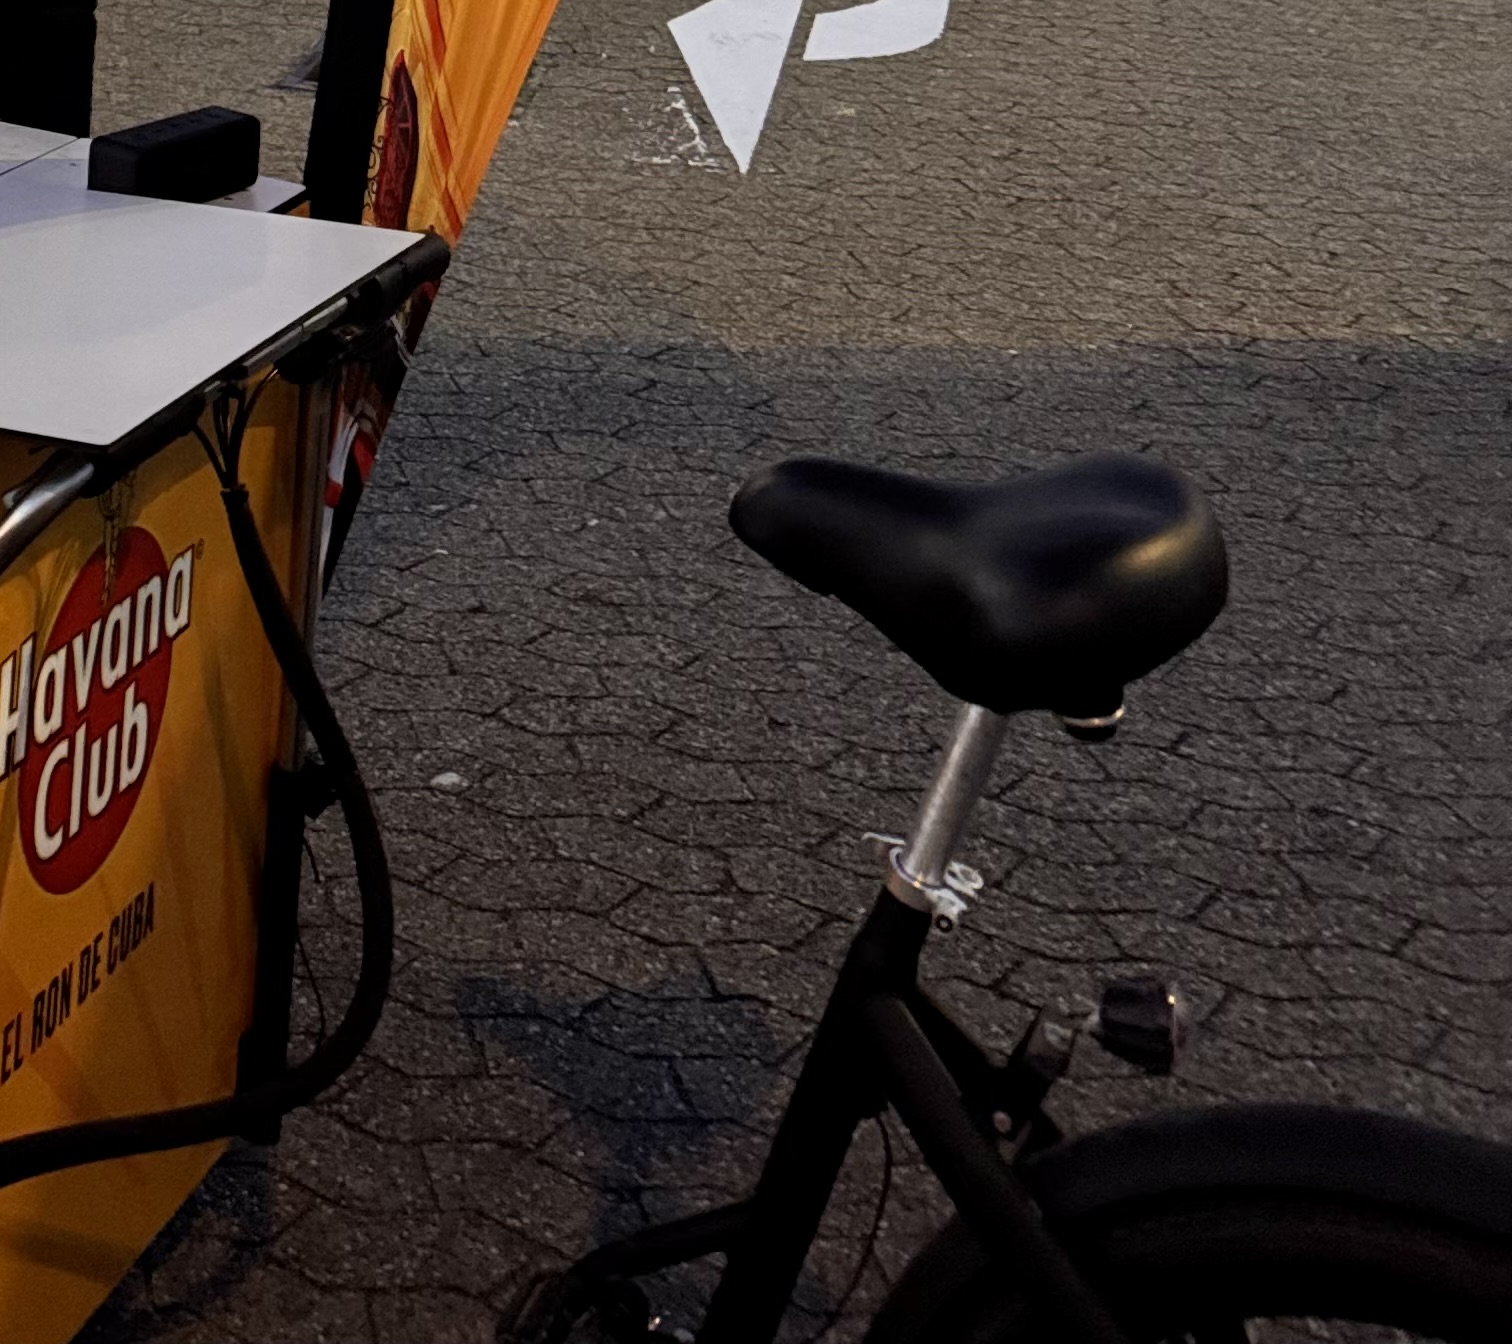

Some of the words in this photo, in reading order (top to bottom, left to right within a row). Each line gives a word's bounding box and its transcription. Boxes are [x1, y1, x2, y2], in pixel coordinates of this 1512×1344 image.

[31, 683, 150, 863] Club
[0, 1012, 24, 1086] EL
[31, 962, 73, 1055] RON
[78, 931, 103, 1005] DE
[107, 881, 154, 975] CUBA
